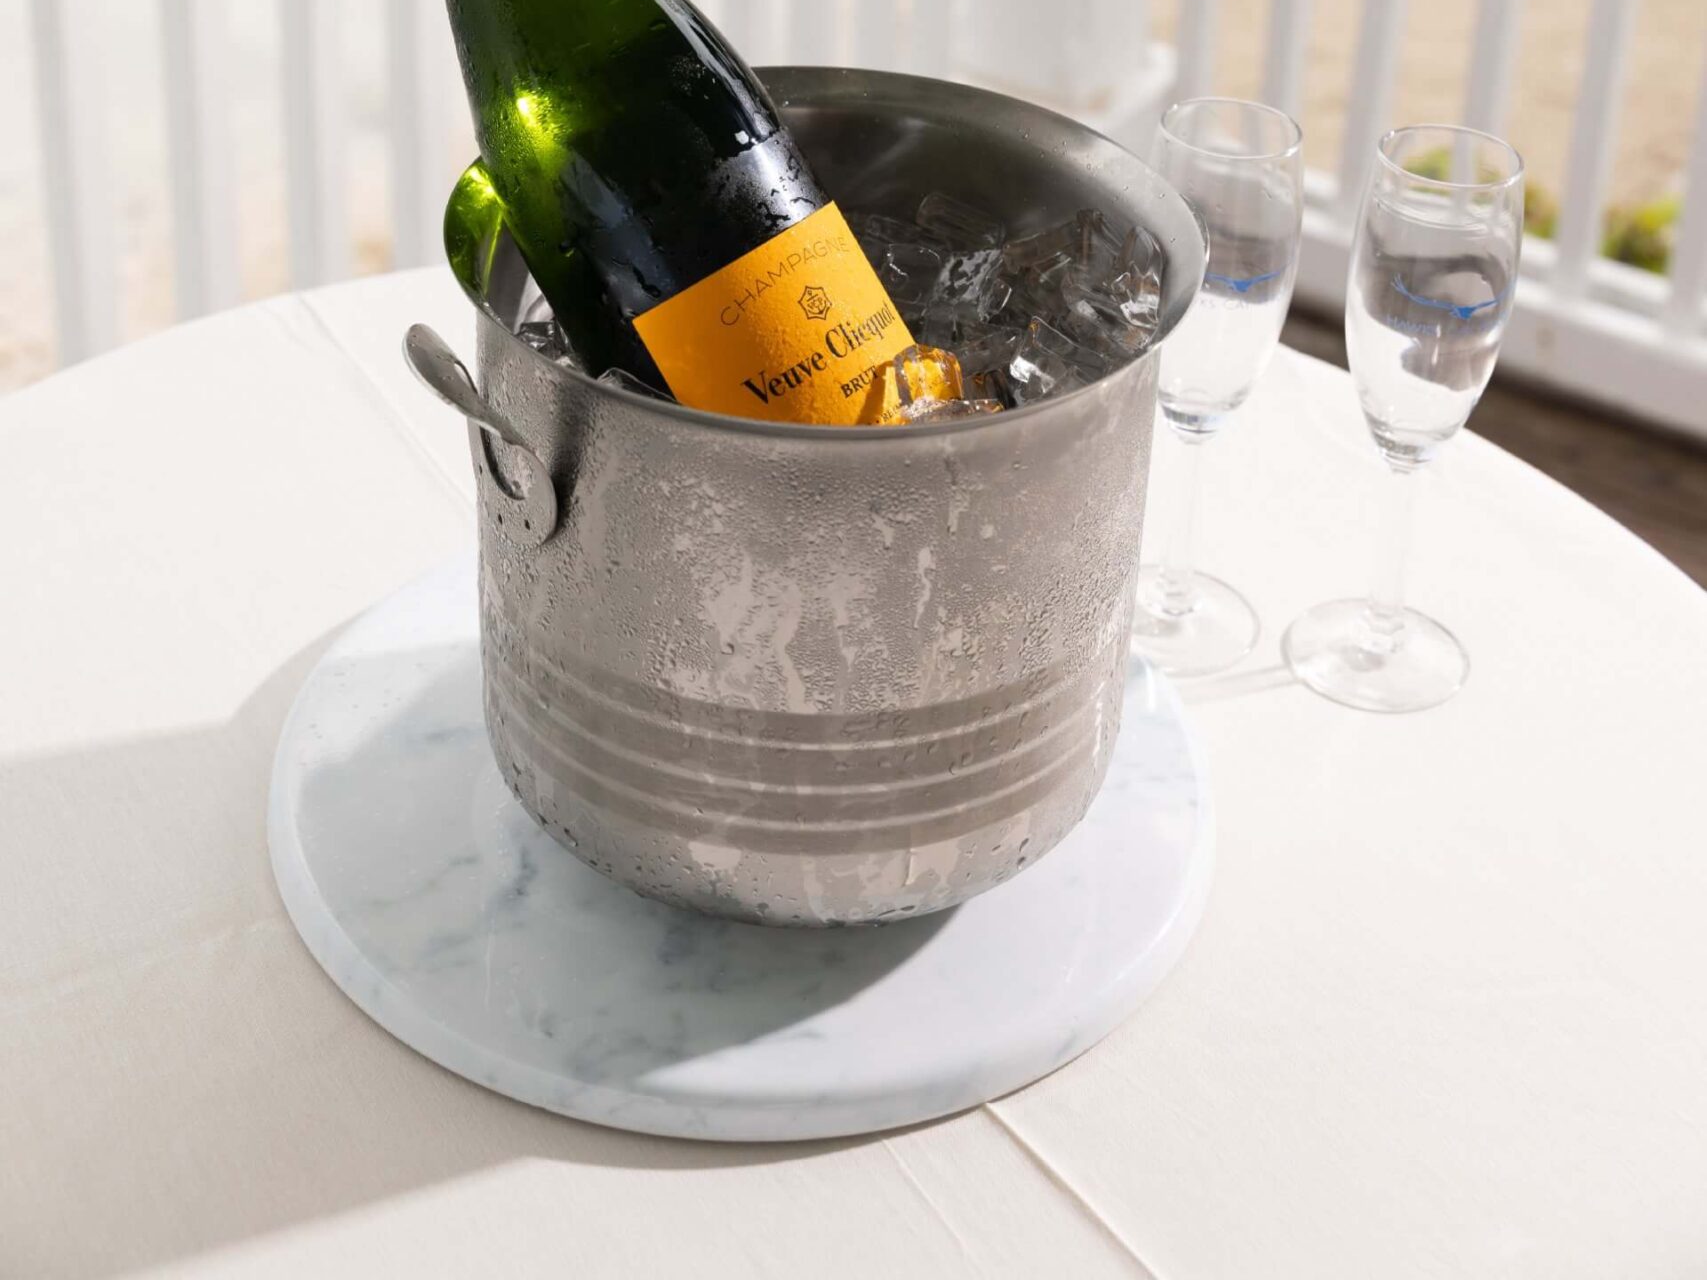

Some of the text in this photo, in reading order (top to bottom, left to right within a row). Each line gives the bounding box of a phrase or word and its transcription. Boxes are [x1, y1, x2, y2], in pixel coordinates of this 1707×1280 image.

[720, 236, 852, 327] CHAMPAGNE
[741, 301, 896, 406] Veuve Clicquot
[840, 365, 880, 399] BRUT
